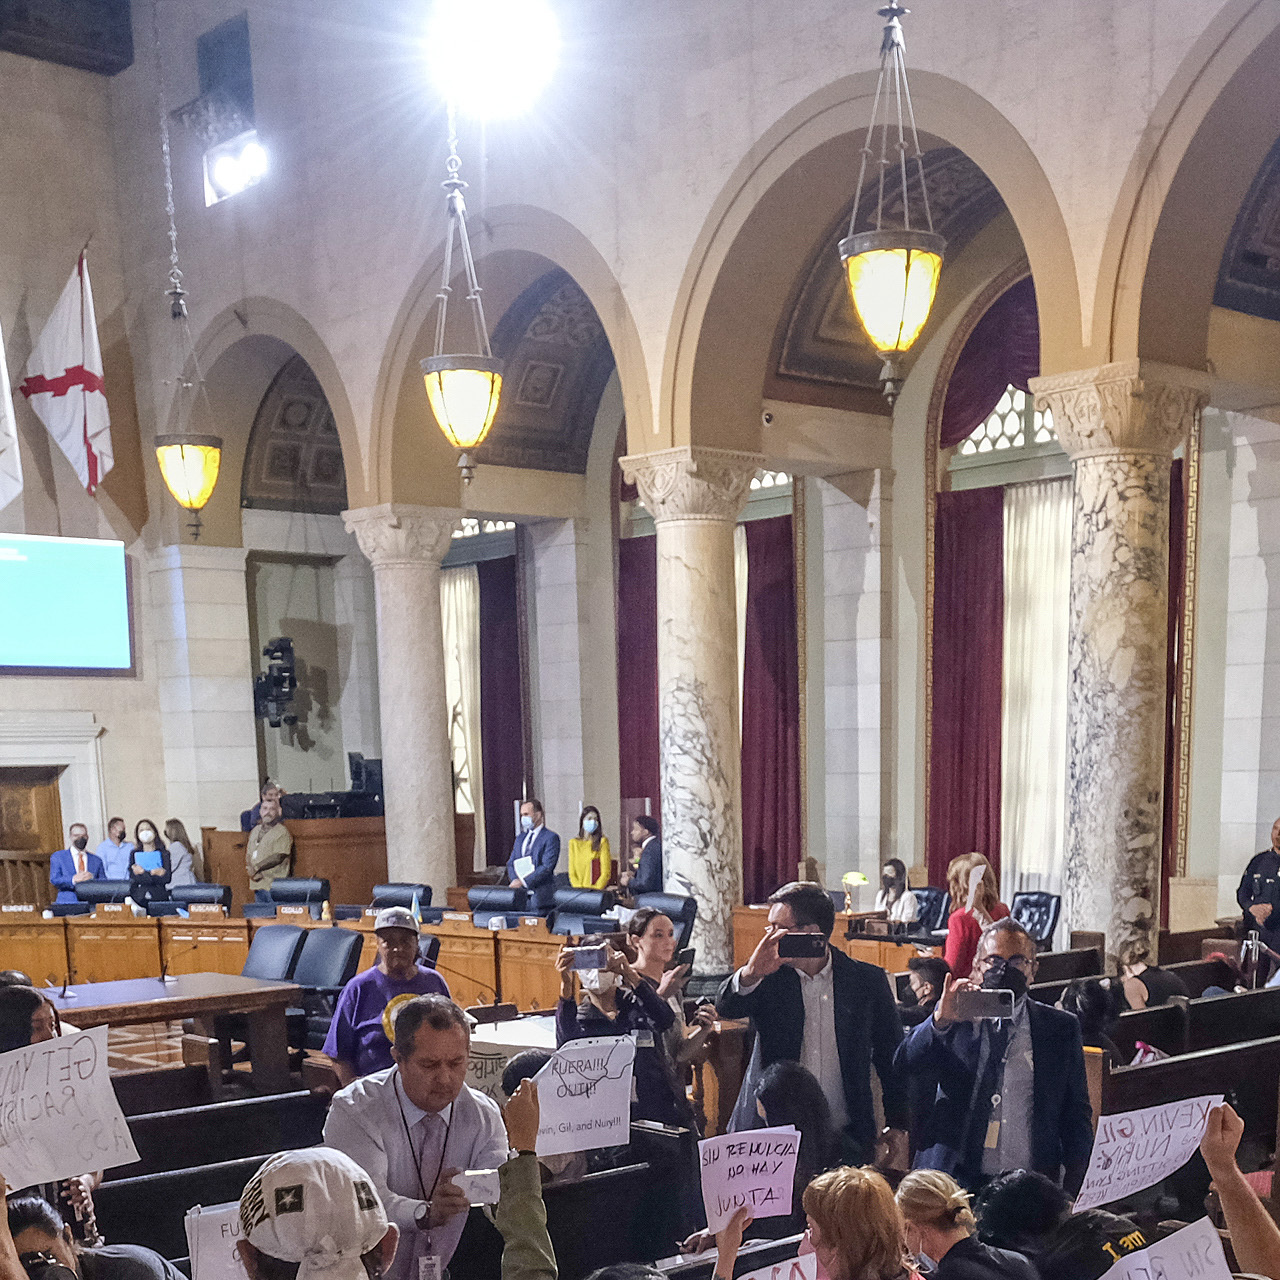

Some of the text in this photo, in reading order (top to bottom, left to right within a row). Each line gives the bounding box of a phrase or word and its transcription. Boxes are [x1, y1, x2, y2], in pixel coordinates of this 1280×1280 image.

[576, 1120, 593, 1130] and
[702, 1141, 796, 1167] SIN RENUNCIA
[727, 1160, 783, 1181] NO HAY
[715, 1187, 780, 1217] JUNTA
